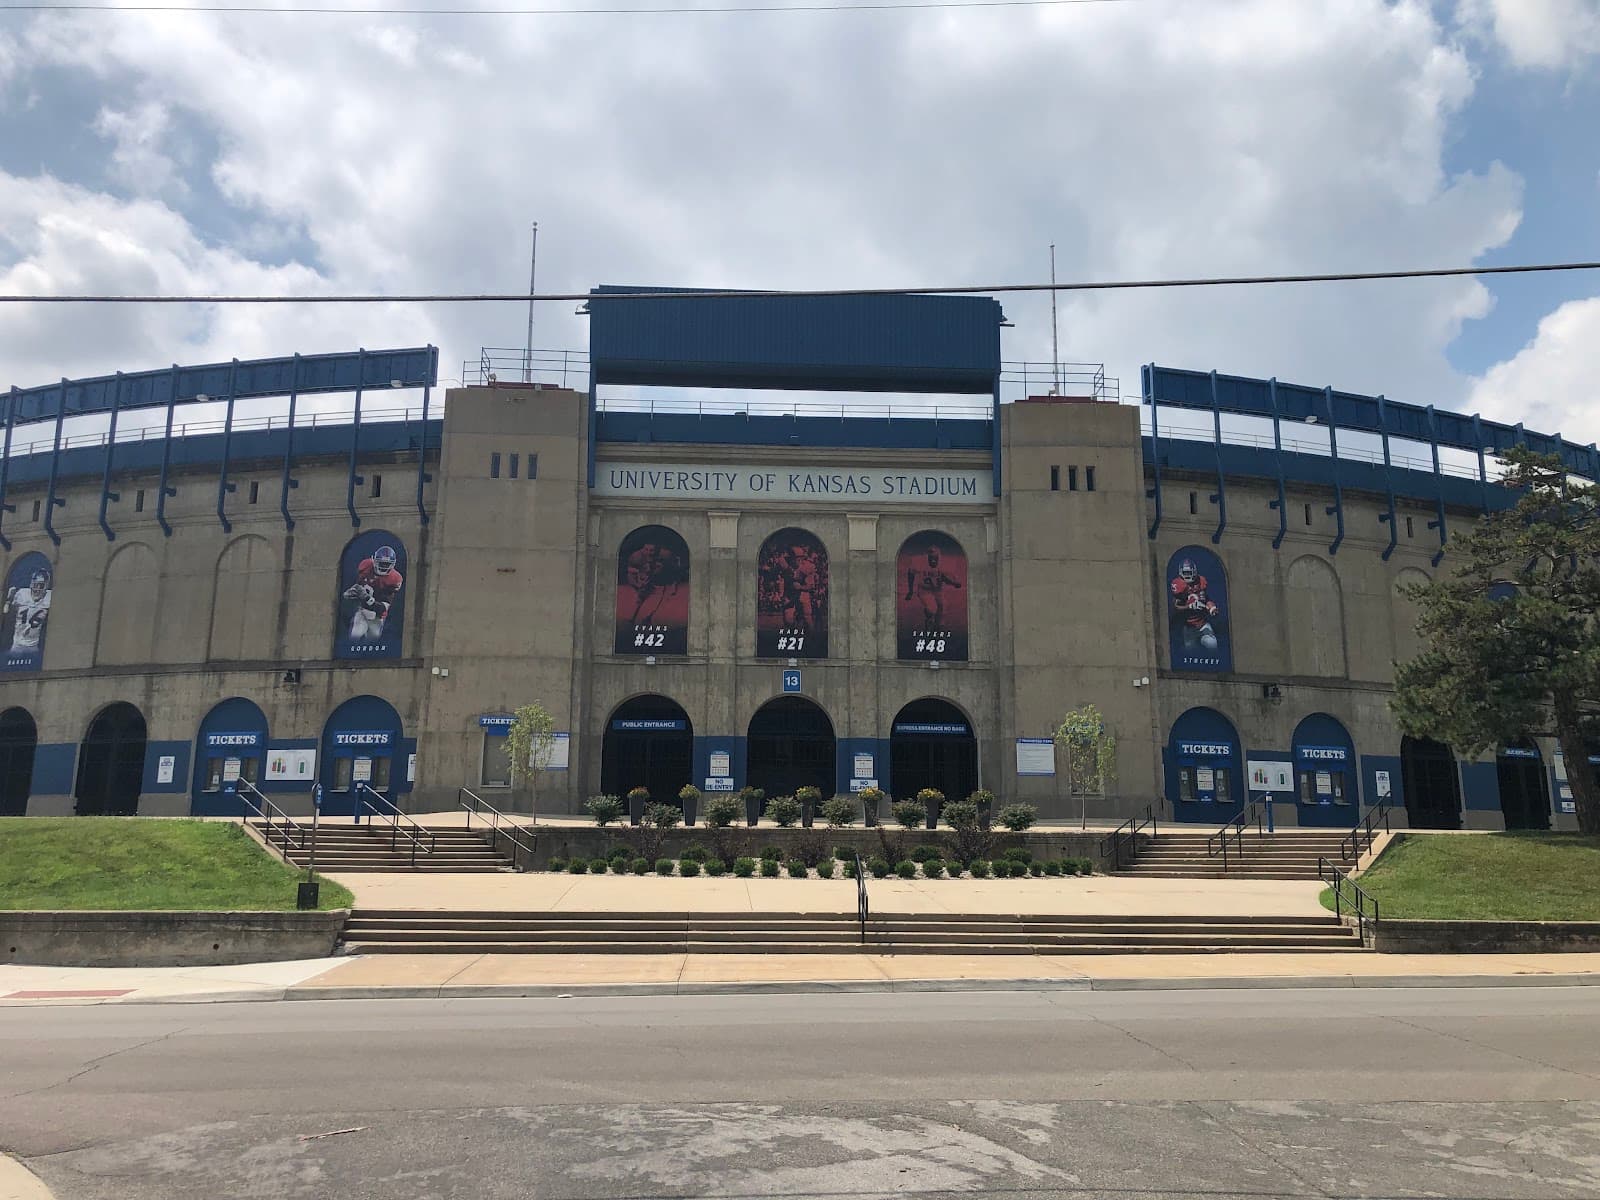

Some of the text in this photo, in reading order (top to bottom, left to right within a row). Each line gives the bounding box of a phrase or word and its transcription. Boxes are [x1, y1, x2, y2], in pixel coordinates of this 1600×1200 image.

[610, 470, 977, 496] UNIVERSITY OF KANSAS STADIUM
[912, 630, 952, 638] SAYERS
[634, 633, 665, 647] #42
[777, 637, 805, 650] #21
[915, 639, 946, 653] #48
[785, 676, 798, 686] 13
[209, 735, 257, 745] TICKETS
[337, 734, 389, 744] TICKETS
[1182, 744, 1230, 754] TICKETS
[1303, 749, 1346, 759] TICKETS
